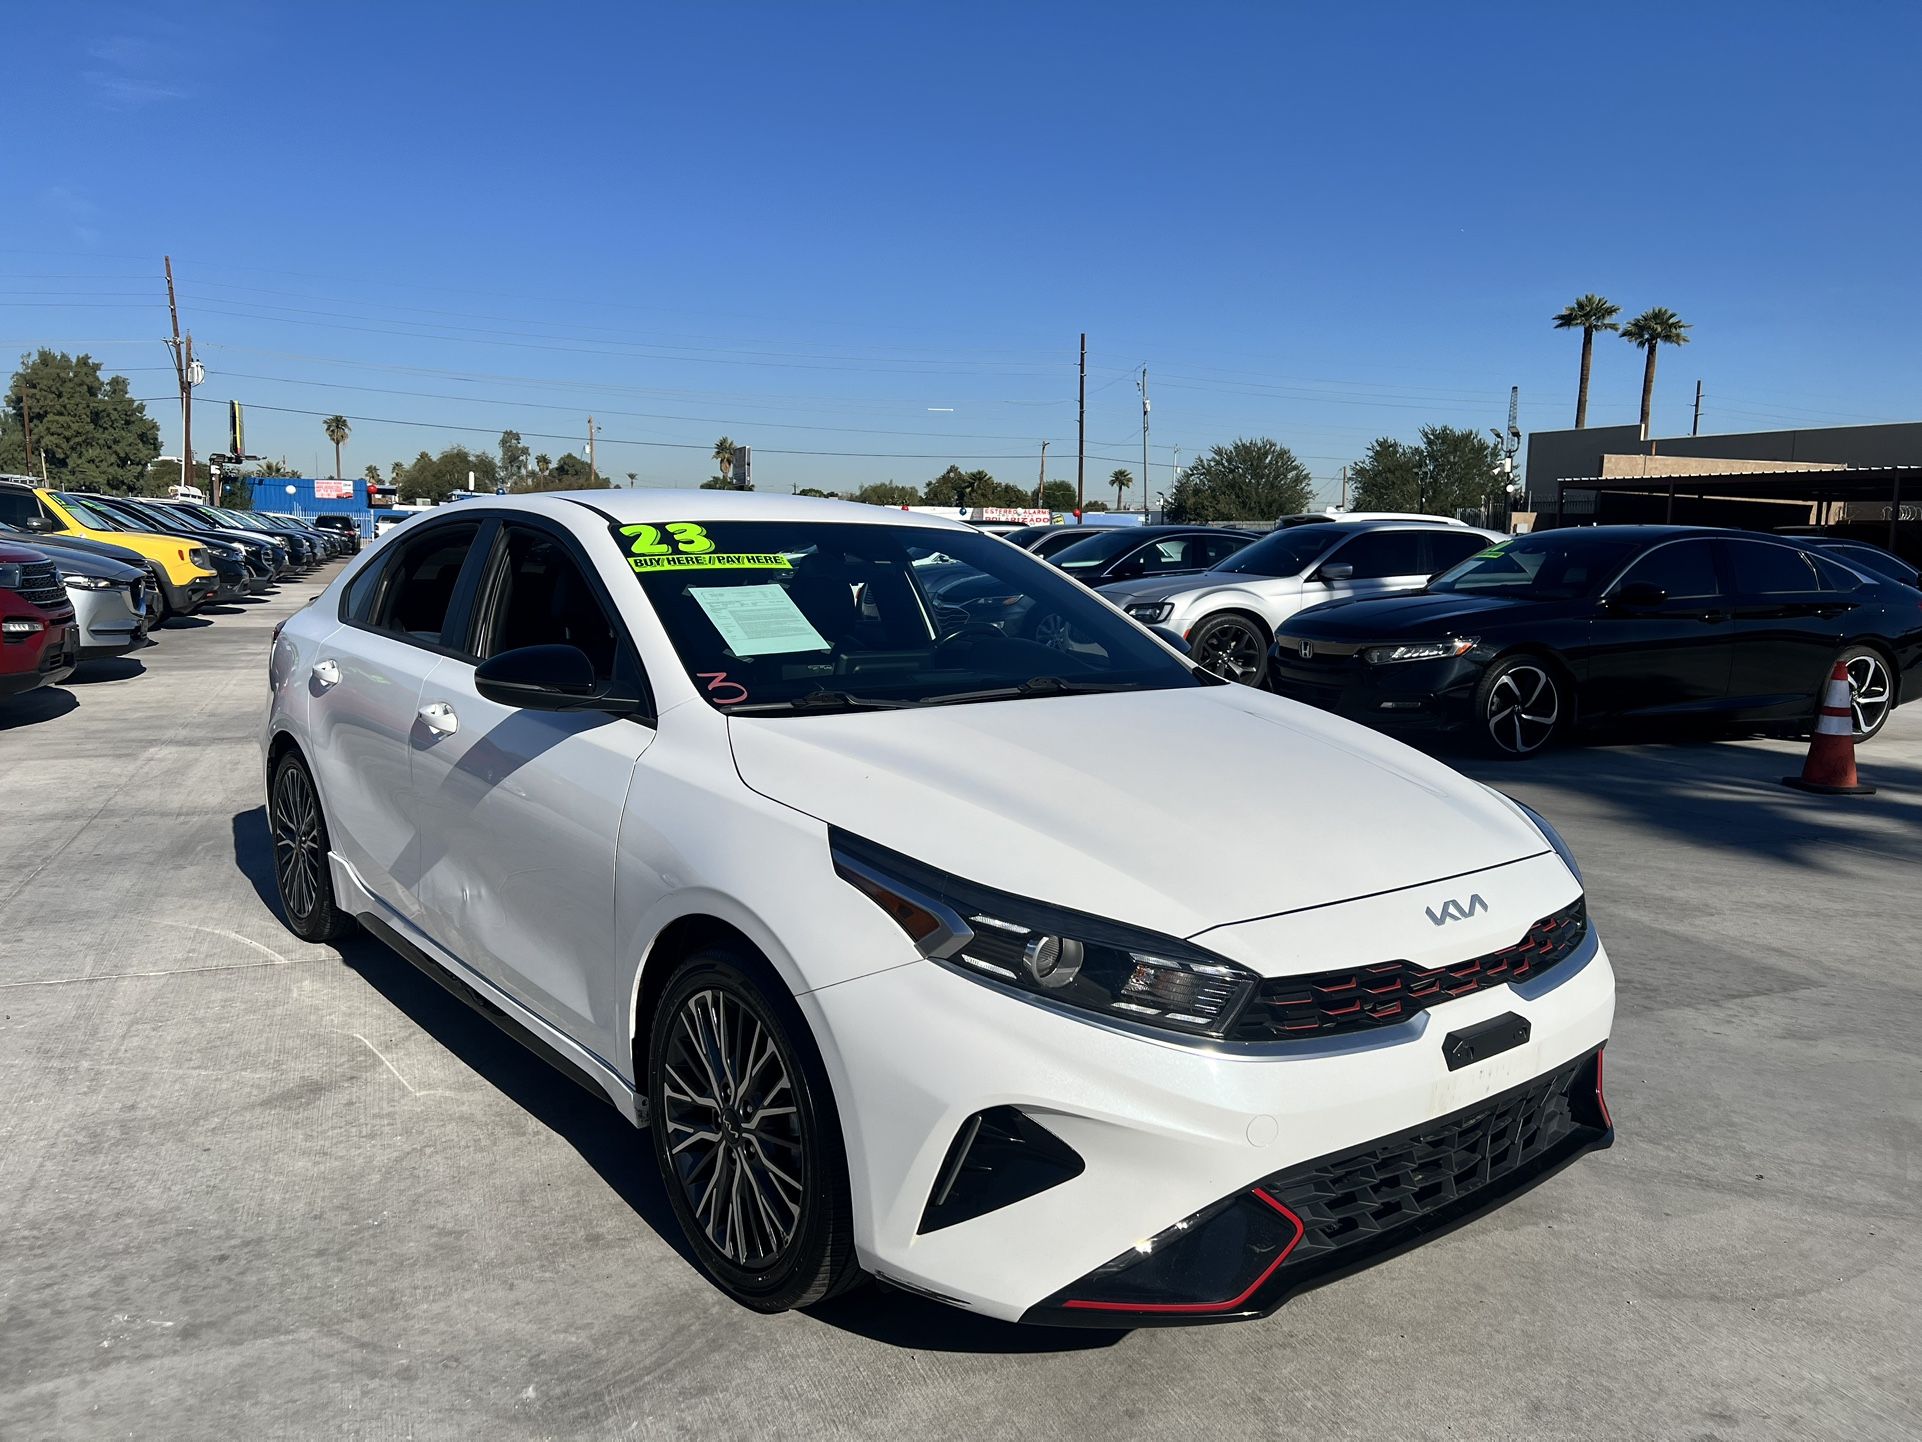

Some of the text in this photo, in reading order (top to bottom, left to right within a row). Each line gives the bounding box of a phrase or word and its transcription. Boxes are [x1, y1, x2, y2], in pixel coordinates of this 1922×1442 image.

[619, 522, 716, 555] 23
[633, 557, 664, 568] BUY
[667, 556, 706, 566] HERE
[715, 555, 745, 565] PAY
[744, 555, 785, 564] HERE
[696, 672, 748, 704] 3
[1424, 893, 1489, 927] KIA
